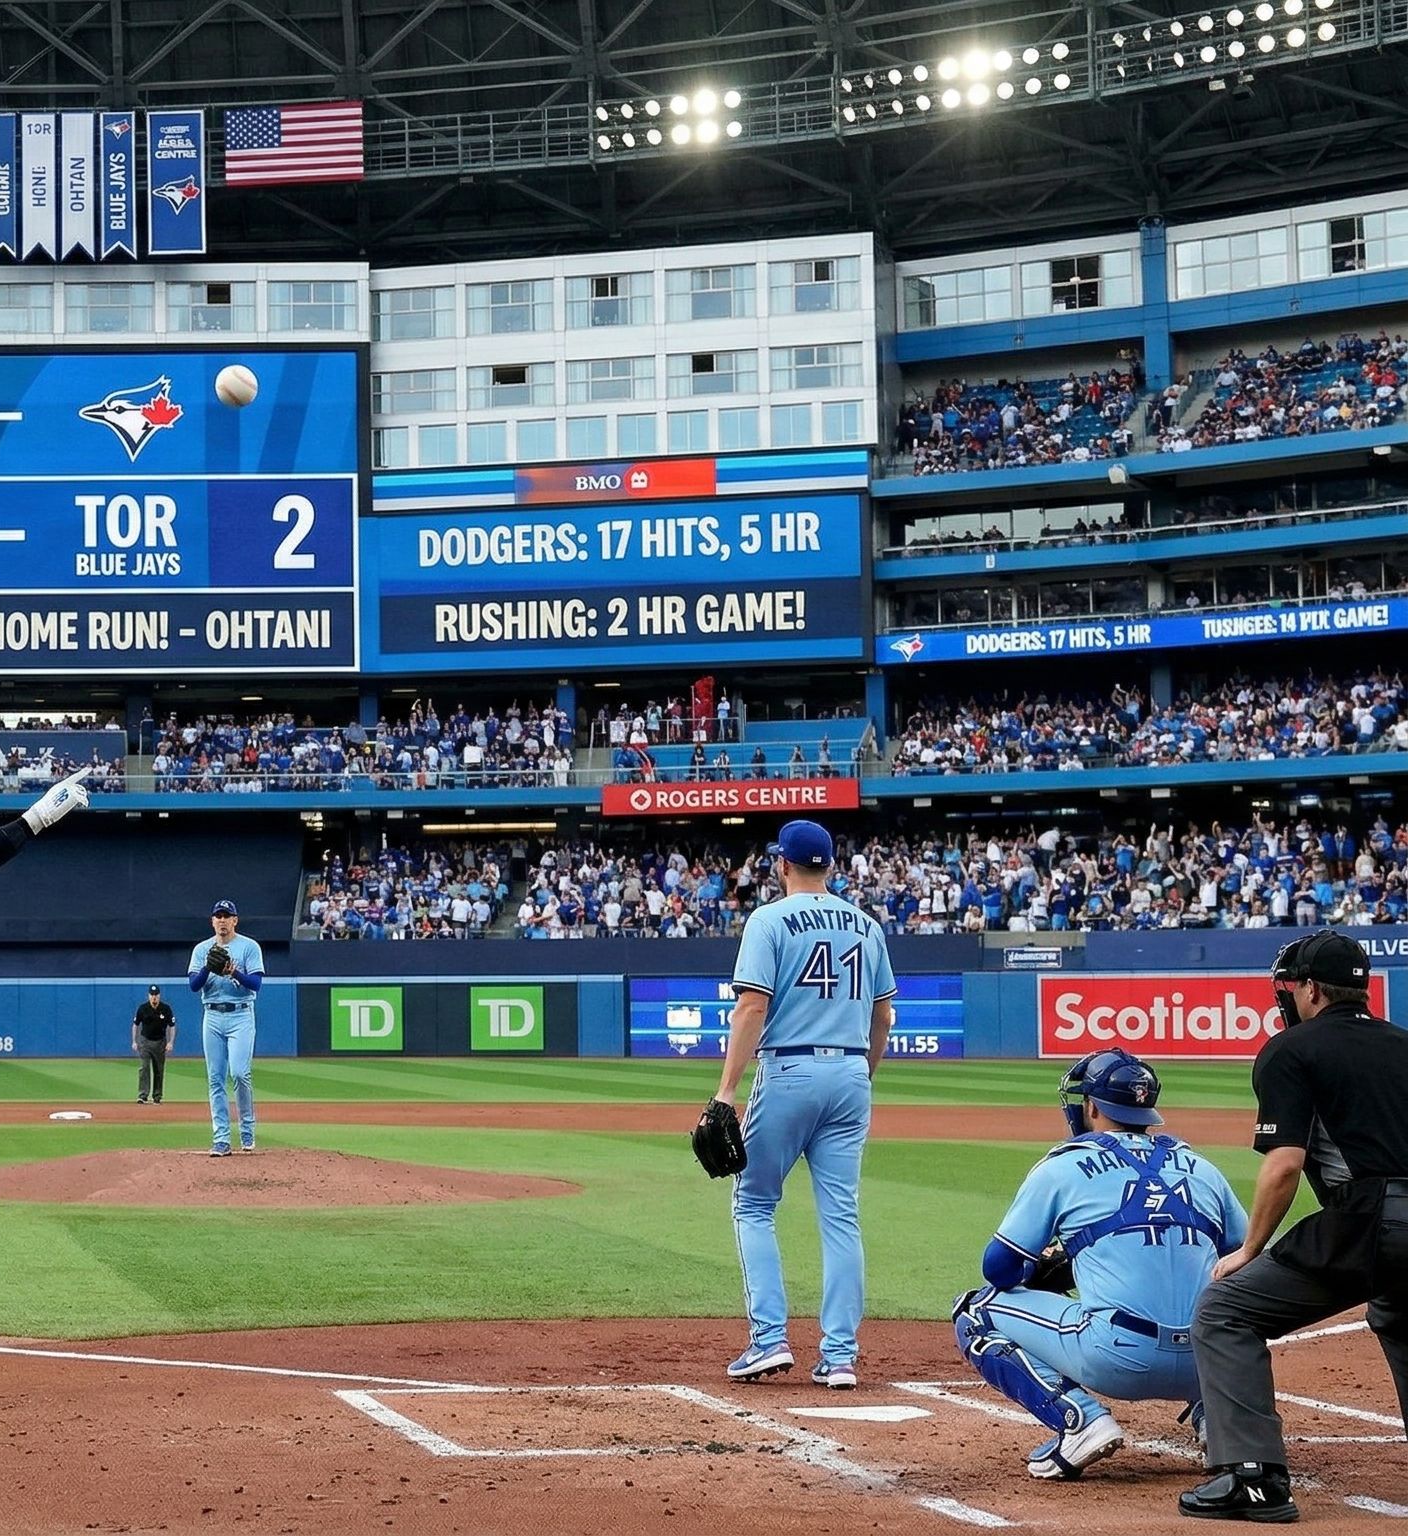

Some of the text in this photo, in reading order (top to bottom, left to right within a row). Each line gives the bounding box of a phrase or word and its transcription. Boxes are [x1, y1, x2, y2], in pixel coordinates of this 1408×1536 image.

[154, 149, 197, 159] CENTRE
[69, 157, 85, 212] OHTAN
[109, 152, 126, 230] BLUE JAYS
[575, 475, 621, 491] BMO
[75, 495, 177, 547] TOR
[272, 495, 316, 570] 2
[418, 511, 821, 567] DODGERS: 17 HITS, 5 HR
[76, 552, 181, 576] BLUE JAYS
[89, 612, 169, 651] RUN!
[205, 611, 332, 650] OHTANI
[434, 591, 806, 643] RUSHING: 2 HR GAME!
[1334, 605, 1388, 628] GAME!
[966, 625, 1151, 654] DODGERS: 17 HITS, 5 HR
[657, 786, 827, 808] ROGERS CENTRE
[782, 909, 872, 939] MANTIPLY
[794, 940, 863, 1000] 41
[338, 999, 395, 1038] TD
[478, 999, 535, 1038] TD
[1247, 1486, 1266, 1502] N
